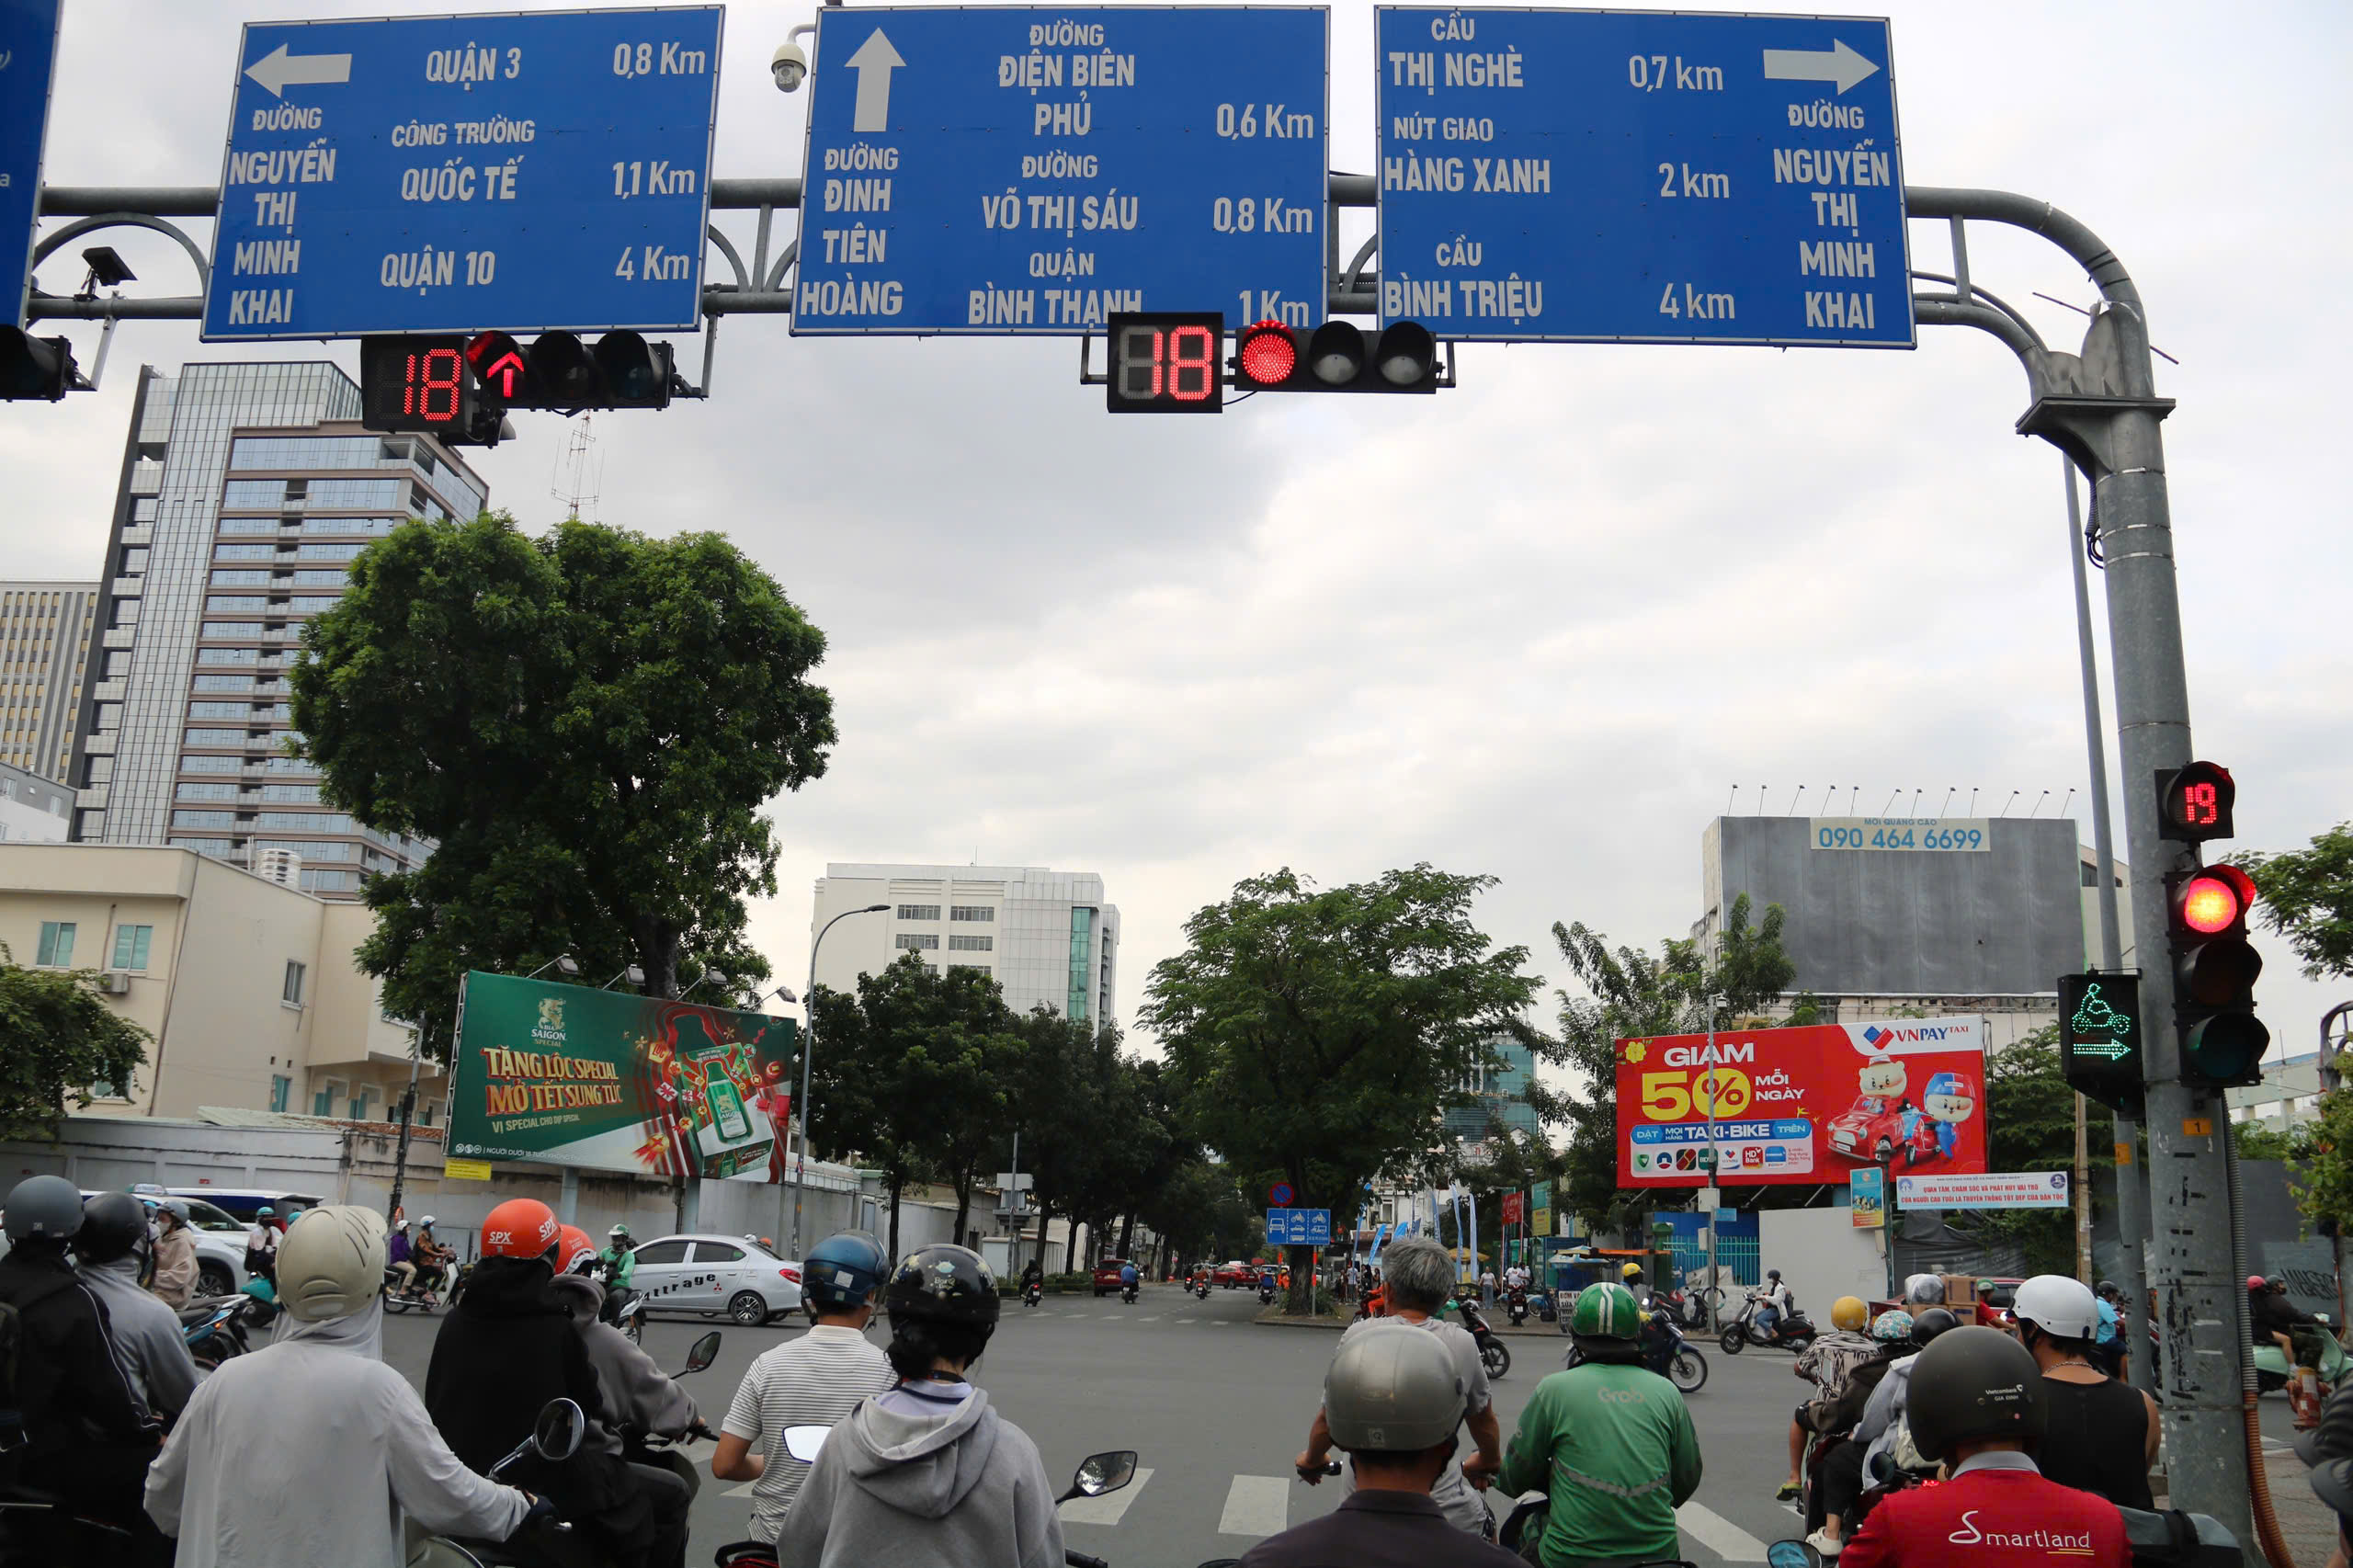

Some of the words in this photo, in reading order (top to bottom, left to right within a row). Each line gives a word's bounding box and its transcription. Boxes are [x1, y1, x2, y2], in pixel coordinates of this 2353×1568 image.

[1029, 19, 1104, 47] ĐƯỜNG
[1431, 12, 1475, 41] CẦU
[426, 40, 497, 91] QUẬN
[505, 47, 522, 79] 3
[613, 42, 653, 79] 0,8
[659, 41, 706, 75] Km
[998, 48, 1063, 96] ĐIỆN
[1072, 47, 1135, 87] BIÊN
[1388, 51, 1435, 96] THỊ
[1445, 44, 1524, 87] NGHÈ
[1629, 55, 1667, 93] 0,7
[1675, 56, 1723, 91] km
[253, 104, 323, 131] ĐƯỜNG
[1034, 90, 1091, 136] PHỦ
[1216, 103, 1256, 141] 0,6
[1265, 104, 1313, 139] Km
[1393, 117, 1437, 141] NÚT
[1442, 117, 1494, 142] GIAO
[1788, 100, 1865, 130] ĐƯỜNG
[392, 122, 448, 148] CÔNG
[454, 117, 536, 144] TRƯỜNG
[229, 137, 336, 186] NGUYỄN
[824, 143, 899, 171] ĐƯỜNG
[1021, 151, 1098, 178] ĐƯỜNG
[1384, 149, 1464, 192] HÀNG
[1472, 158, 1551, 194] XANH
[1773, 138, 1891, 187] NGUYỄN
[401, 156, 476, 202] QUỐC
[484, 154, 525, 200] TẾ
[612, 161, 642, 199] 1,1
[648, 161, 696, 195] Km
[824, 178, 892, 212] ĐINH
[1658, 163, 1677, 198] 2
[1682, 163, 1730, 199] km
[255, 191, 297, 234] THỊ
[982, 187, 1021, 230] VÕ
[1027, 195, 1075, 238] THỊ
[1081, 187, 1138, 231] SÁU
[1213, 197, 1256, 234] 0,8
[1264, 198, 1313, 233] Km
[1811, 192, 1859, 237] THỊ
[233, 239, 301, 276] MINH
[823, 222, 886, 264] TIÊN
[1436, 237, 1482, 267] CẦU
[1800, 241, 1876, 278] MINH
[381, 244, 455, 296] QUẬN
[465, 251, 495, 286] 10
[615, 246, 634, 281] 4
[642, 245, 689, 280] Km
[1029, 246, 1095, 282] QUẬN
[229, 289, 293, 324] KHAI
[800, 272, 904, 316] HOÀNG
[968, 281, 1035, 324] BÌNH
[1044, 290, 1142, 328] THẠNH
[1240, 290, 1253, 326] 1
[1259, 290, 1310, 326] Km
[1384, 271, 1451, 317] BÌNH
[1459, 273, 1542, 325] TRIỆU
[1659, 283, 1680, 319] 4
[1686, 283, 1735, 319] km
[1805, 290, 1875, 329] KHAI
[1153, 324, 1213, 401] 18
[404, 348, 461, 421] 18
[2185, 782, 2216, 824] 19
[1818, 827, 1863, 848] 090
[1871, 828, 1915, 849] 464
[1924, 829, 1983, 849] 6699
[531, 1028, 566, 1040] SAIGON
[535, 1039, 562, 1048] SPECIAL
[1895, 1027, 1949, 1042] VNPAY
[482, 1044, 543, 1080] TẶNG
[544, 1051, 575, 1083] LỘC
[574, 1058, 620, 1080] SPECIAL
[1665, 1038, 1755, 1067] GIẢM
[1756, 1068, 1789, 1086] MỖI
[1756, 1087, 1804, 1101] NGÀY
[485, 1078, 529, 1116] MỞ
[529, 1079, 564, 1112] TẾT
[564, 1085, 602, 1108] SUNG
[601, 1082, 624, 1104] TÚC
[492, 1120, 504, 1134] VỊ
[506, 1118, 540, 1133] SPECIAL
[540, 1116, 553, 1126] CHO
[1685, 1124, 1770, 1140] TAXI-BIKE
[1777, 1123, 1806, 1133] TRÊN
[2194, 1121, 2200, 1133] 1
[489, 1232, 512, 1243] SPX
[539, 1216, 557, 1238] SPX
[1597, 1386, 1646, 1403] Grab
[1949, 1510, 2090, 1548] Smartland
